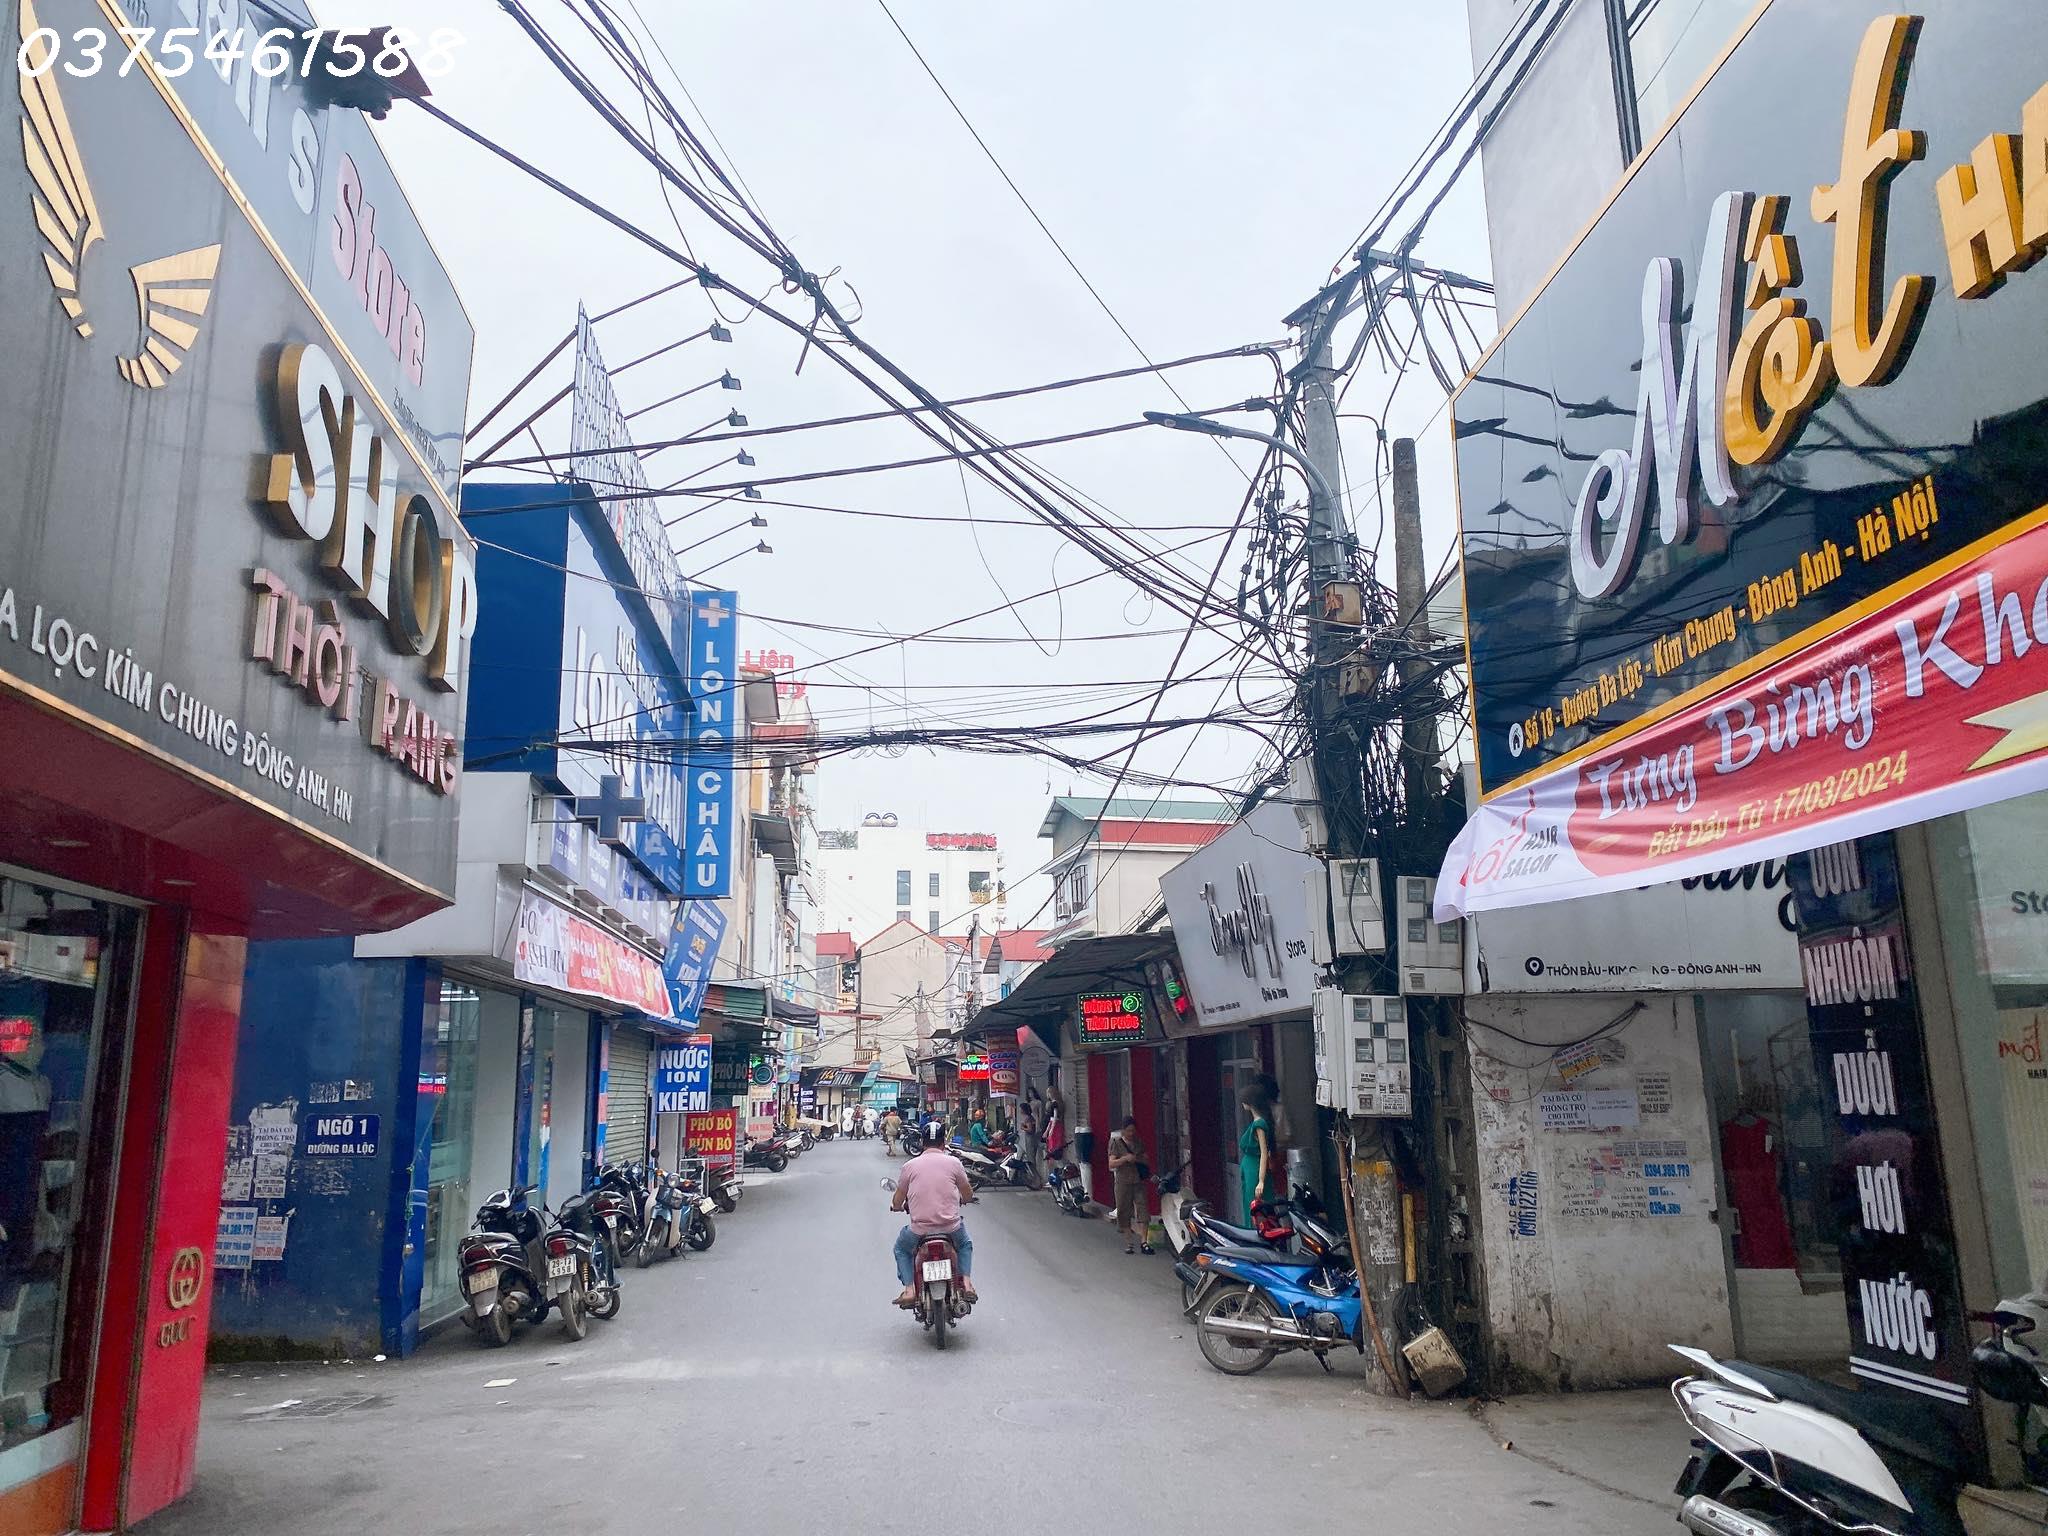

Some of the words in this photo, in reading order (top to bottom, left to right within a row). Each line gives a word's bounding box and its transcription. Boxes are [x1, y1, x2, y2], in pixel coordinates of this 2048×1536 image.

[1571, 14, 1937, 599] Mốt
[266, 343, 478, 693] SHOP
[1540, 706, 1555, 740] 18
[1600, 673, 1618, 708] Đa
[1618, 658, 1644, 700] Lộc
[1652, 634, 1684, 678] Kim
[1684, 607, 1737, 659] Chung
[1747, 567, 1799, 624] Đông
[1799, 539, 1842, 596] Anh
[1856, 507, 1892, 562] Hà
[1892, 474, 1939, 541] Nội
[744, 649, 794, 669] Liên
[1586, 743, 1698, 821] Tưng
[1704, 661, 1875, 775] Bừng
[1894, 571, 2048, 697] Kh
[158, 681, 238, 757] CHUNG
[241, 731, 294, 792] ĐÔNG
[332, 784, 353, 824] HN
[1771, 750, 1909, 824] 17/03/2024
[1521, 825, 1559, 852] HAIR
[1502, 853, 1559, 880] SALON
[660, 1045, 708, 1070] NƯỚC
[666, 1071, 701, 1083] ION
[658, 1084, 707, 1112] KIỀM
[317, 1115, 354, 1136] NGÕ
[359, 1118, 368, 1136] 1
[690, 1113, 715, 1132] PHỞ
[716, 1112, 733, 1131] BÒ
[356, 1143, 375, 1155] LỘC
[716, 1132, 733, 1151] BÒ
[1856, 1159, 1907, 1236] HƠI
[1859, 1272, 1937, 1361] NƯỚC
